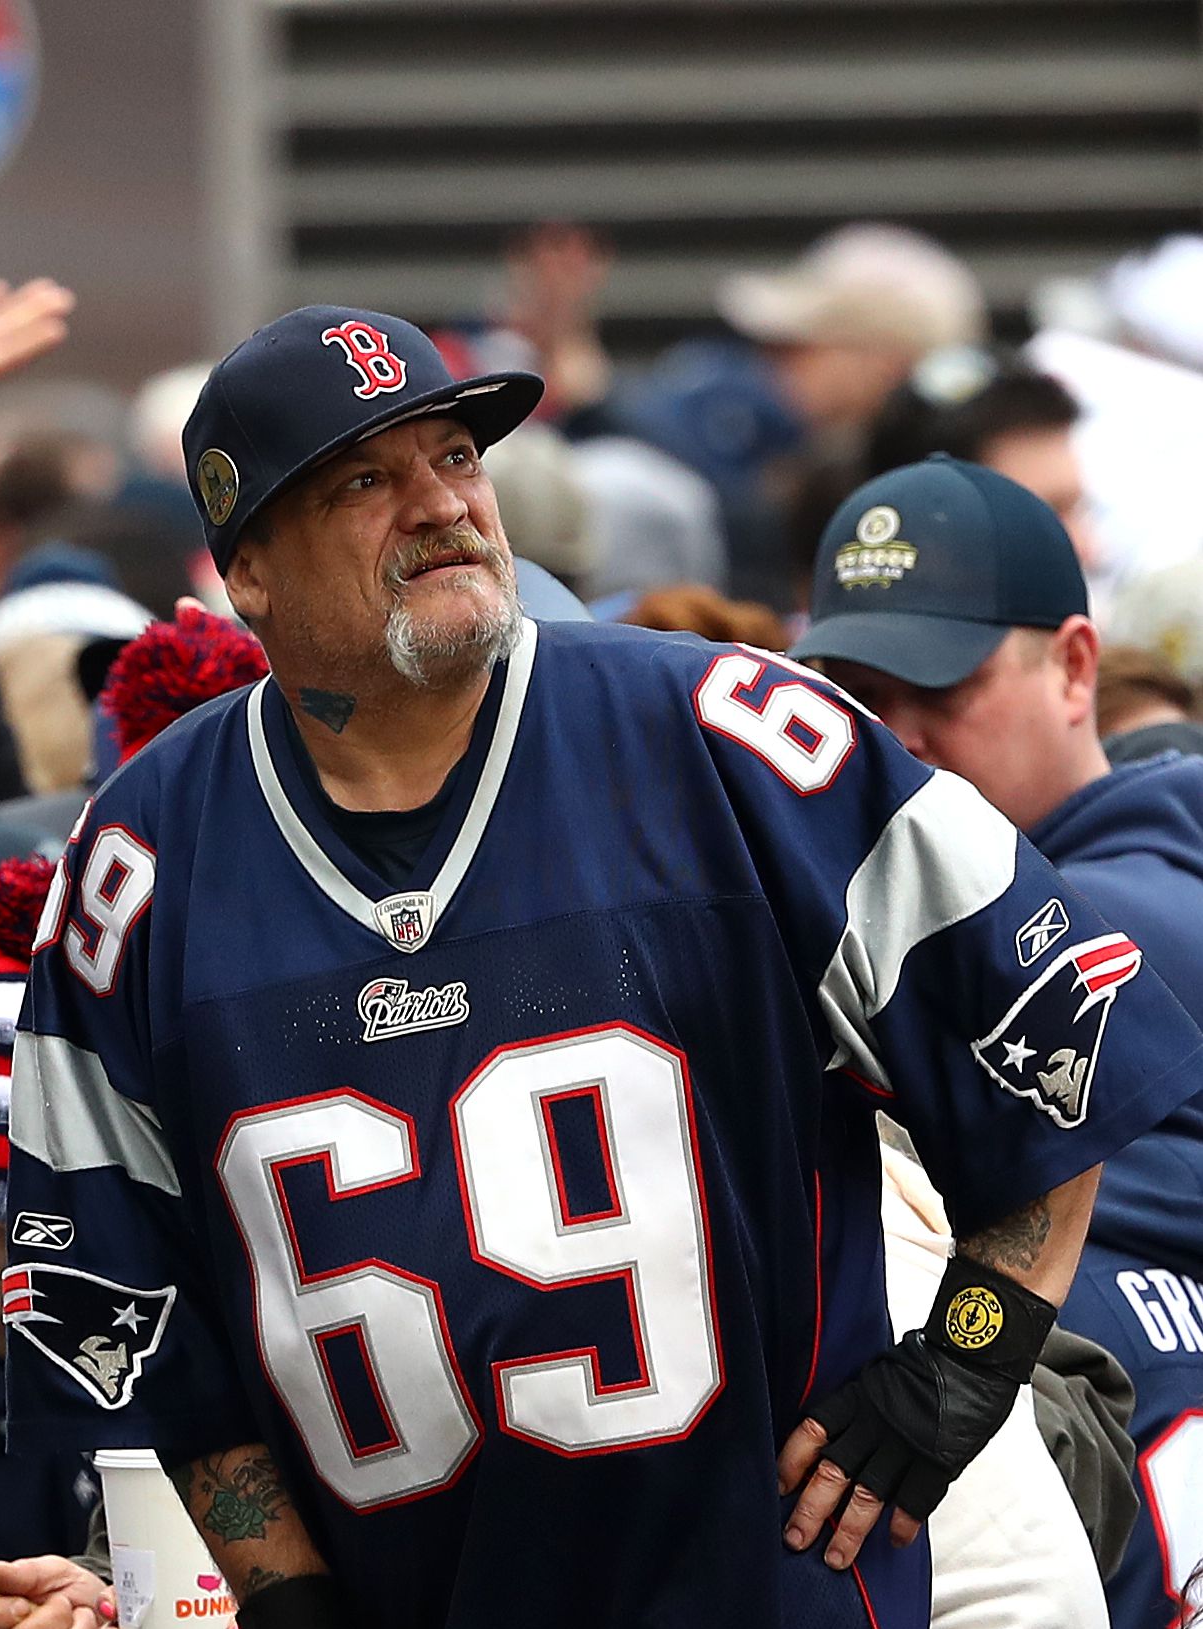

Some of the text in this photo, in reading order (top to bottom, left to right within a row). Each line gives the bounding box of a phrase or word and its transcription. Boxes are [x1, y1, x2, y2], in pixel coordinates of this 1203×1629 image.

[321, 320, 407, 400] B
[692, 637, 885, 798] 6
[397, 922, 420, 941] NFL
[363, 982, 467, 1037] Patriots
[213, 1020, 726, 1515] 69
